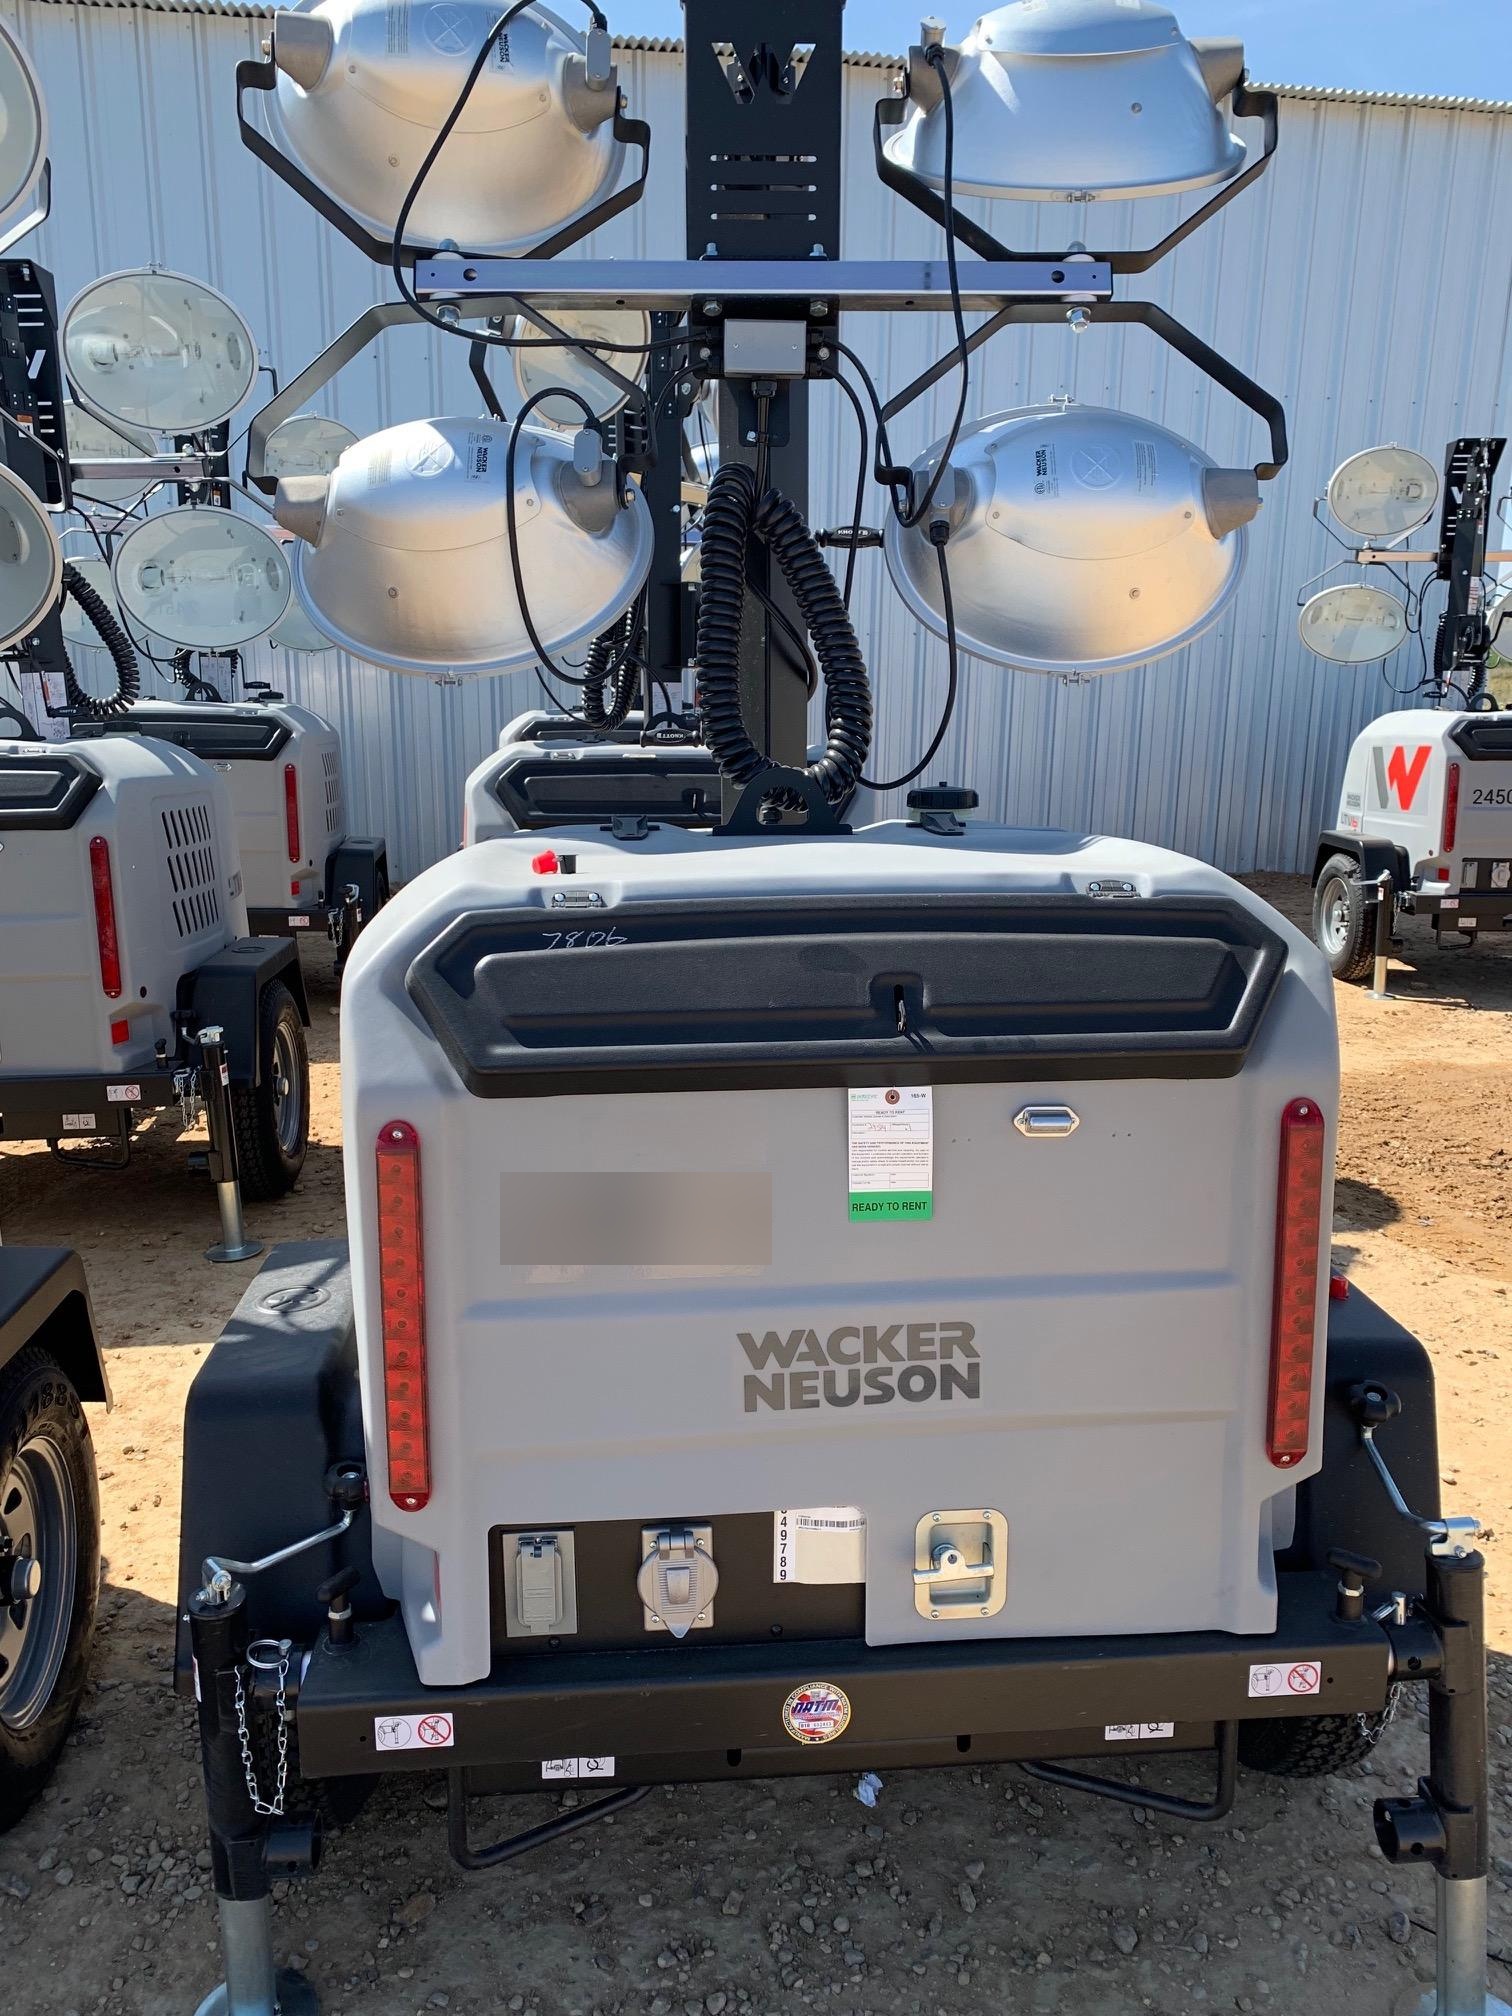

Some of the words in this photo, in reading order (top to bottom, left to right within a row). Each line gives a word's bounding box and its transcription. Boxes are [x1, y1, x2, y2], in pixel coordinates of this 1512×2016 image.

[852, 1203, 884, 1212] READY
[887, 1202, 900, 1211] TO
[902, 1202, 928, 1211] RENT
[736, 1322, 981, 1370] WACKER
[743, 1362, 981, 1413] NEUSON
[792, 1699, 839, 1713] NATM
